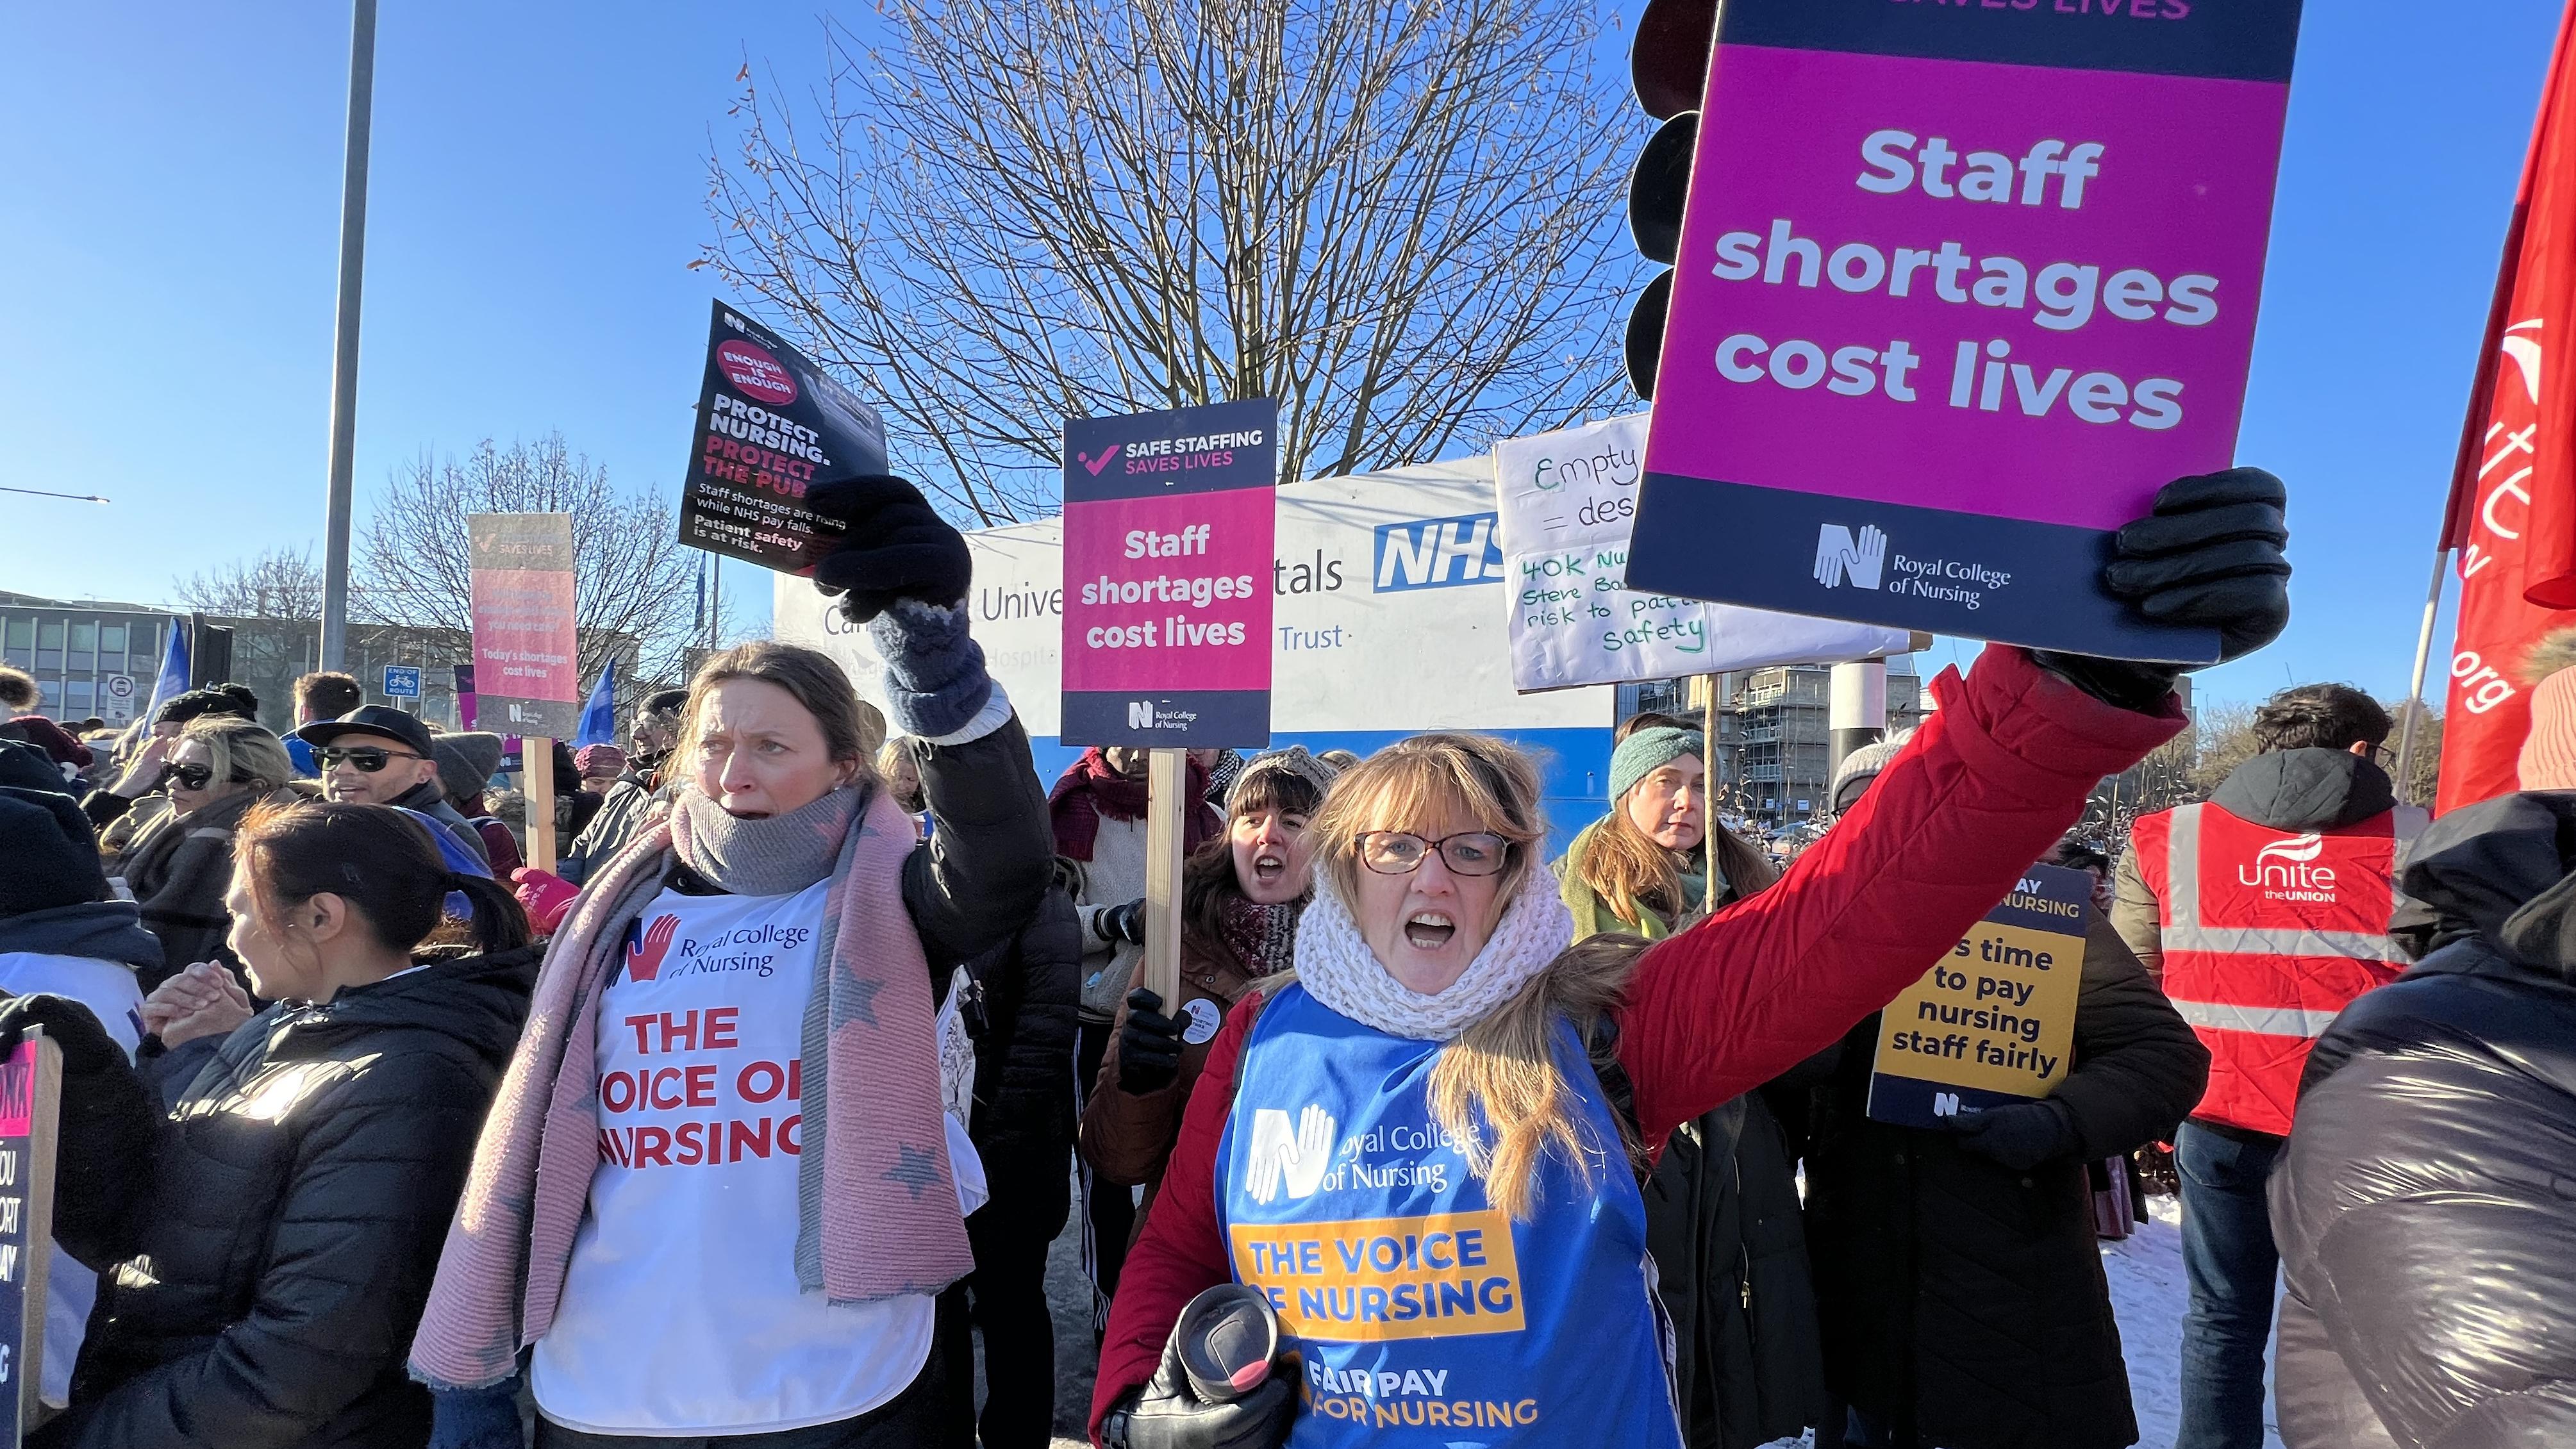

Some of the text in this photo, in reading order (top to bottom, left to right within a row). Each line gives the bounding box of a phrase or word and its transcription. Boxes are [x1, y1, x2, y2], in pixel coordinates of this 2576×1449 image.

[1856, 129, 2106, 209] Staff
[1712, 219, 2219, 332] shortages
[723, 352, 782, 374] ENOUGH
[750, 368, 766, 378] IS
[732, 372, 791, 394] ENOUGH
[1715, 333, 2184, 431] cost lives
[713, 393, 819, 445] PROTECT
[710, 414, 831, 466] NURSING.
[1126, 429, 1263, 458] SAFE STAFFING
[706, 436, 815, 481] PROTECT
[1125, 451, 1233, 476] SAVES LIVES
[1535, 444, 1638, 490] Empty
[703, 456, 808, 499] THE PUB
[697, 497, 814, 534] while NHS pay falls.
[699, 483, 729, 499] Staff
[731, 492, 791, 515] shortages
[794, 509, 813, 521] are
[1579, 495, 1634, 526] des
[499, 545, 553, 555] SAVES LIVES
[694, 526, 763, 554] is at risk.
[695, 515, 803, 551] Patient safety
[1124, 524, 1210, 559] Staff
[1274, 549, 1342, 595] tals
[1893, 554, 2011, 587] Royal College
[983, 581, 1061, 621] Unive
[1081, 575, 1254, 608] shortages
[1523, 588, 1581, 605] Steve
[1888, 577, 1981, 610] of Nursing
[1527, 607, 1575, 627] risk
[1588, 602, 1611, 618] to
[1087, 615, 1245, 649] cost lives
[1279, 624, 1343, 650] Trust
[481, 649, 568, 665] Today's shortages
[503, 667, 547, 678] cost lives
[1155, 711, 1197, 722] Royal College
[1163, 720, 1187, 731] Nursing
[2015, 878, 2042, 894] AY
[2003, 893, 2079, 918] NURSING
[733, 925, 810, 950] College
[1955, 938, 2053, 971] s time
[691, 952, 774, 977] Nursing
[1935, 966, 2034, 1007] to pay
[625, 1007, 738, 1054] THE
[1918, 1000, 2040, 1043] nursing
[1892, 1030, 2058, 1079] staff fairly
[597, 1065, 717, 1113] OICE
[1339, 1125, 1385, 1163] oyal
[1323, 1161, 1448, 1193] of Nursing
[1249, 1229, 1487, 1275] THE VOICE
[1298, 1277, 1514, 1323] NURSING
[1308, 1359, 1449, 1398] FAIR PAY
[1313, 1391, 1538, 1428] FOR NURSING
